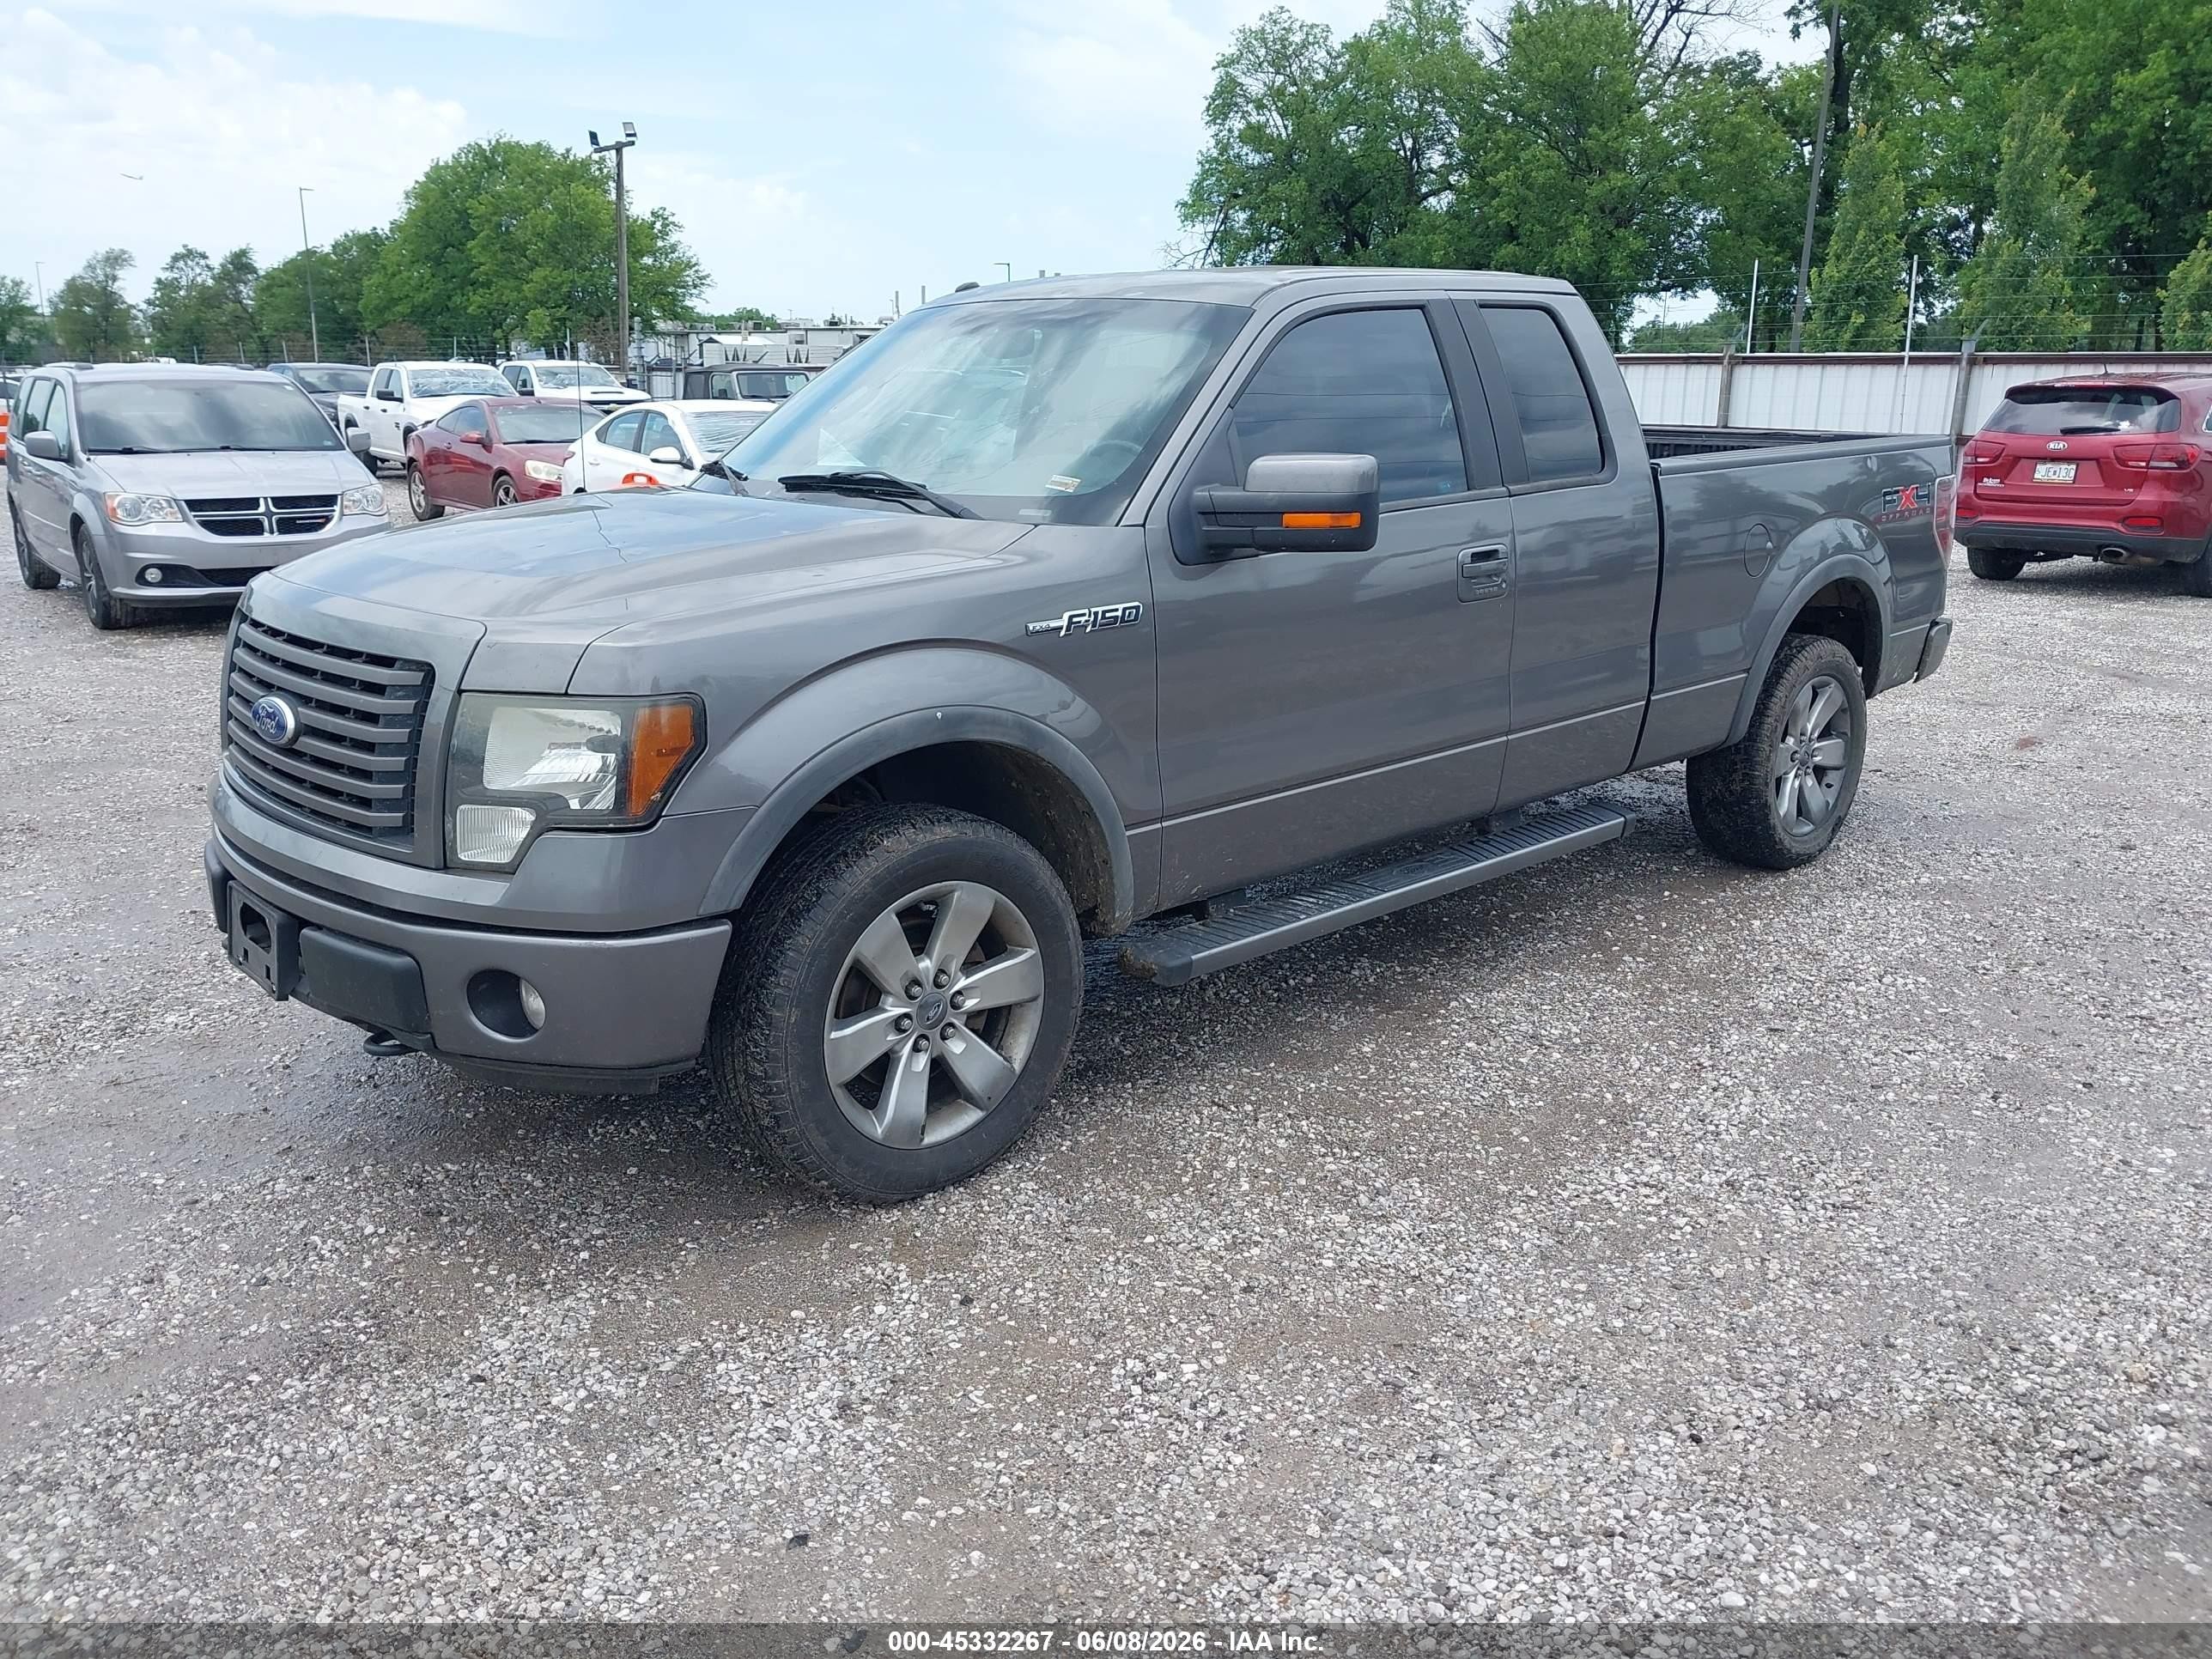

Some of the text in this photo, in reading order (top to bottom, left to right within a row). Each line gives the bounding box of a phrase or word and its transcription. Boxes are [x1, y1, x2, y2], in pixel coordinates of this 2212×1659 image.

[1881, 482, 1931, 514] FX4
[1031, 602, 1143, 637] FX4 F-150
[255, 703, 279, 734] Ford
